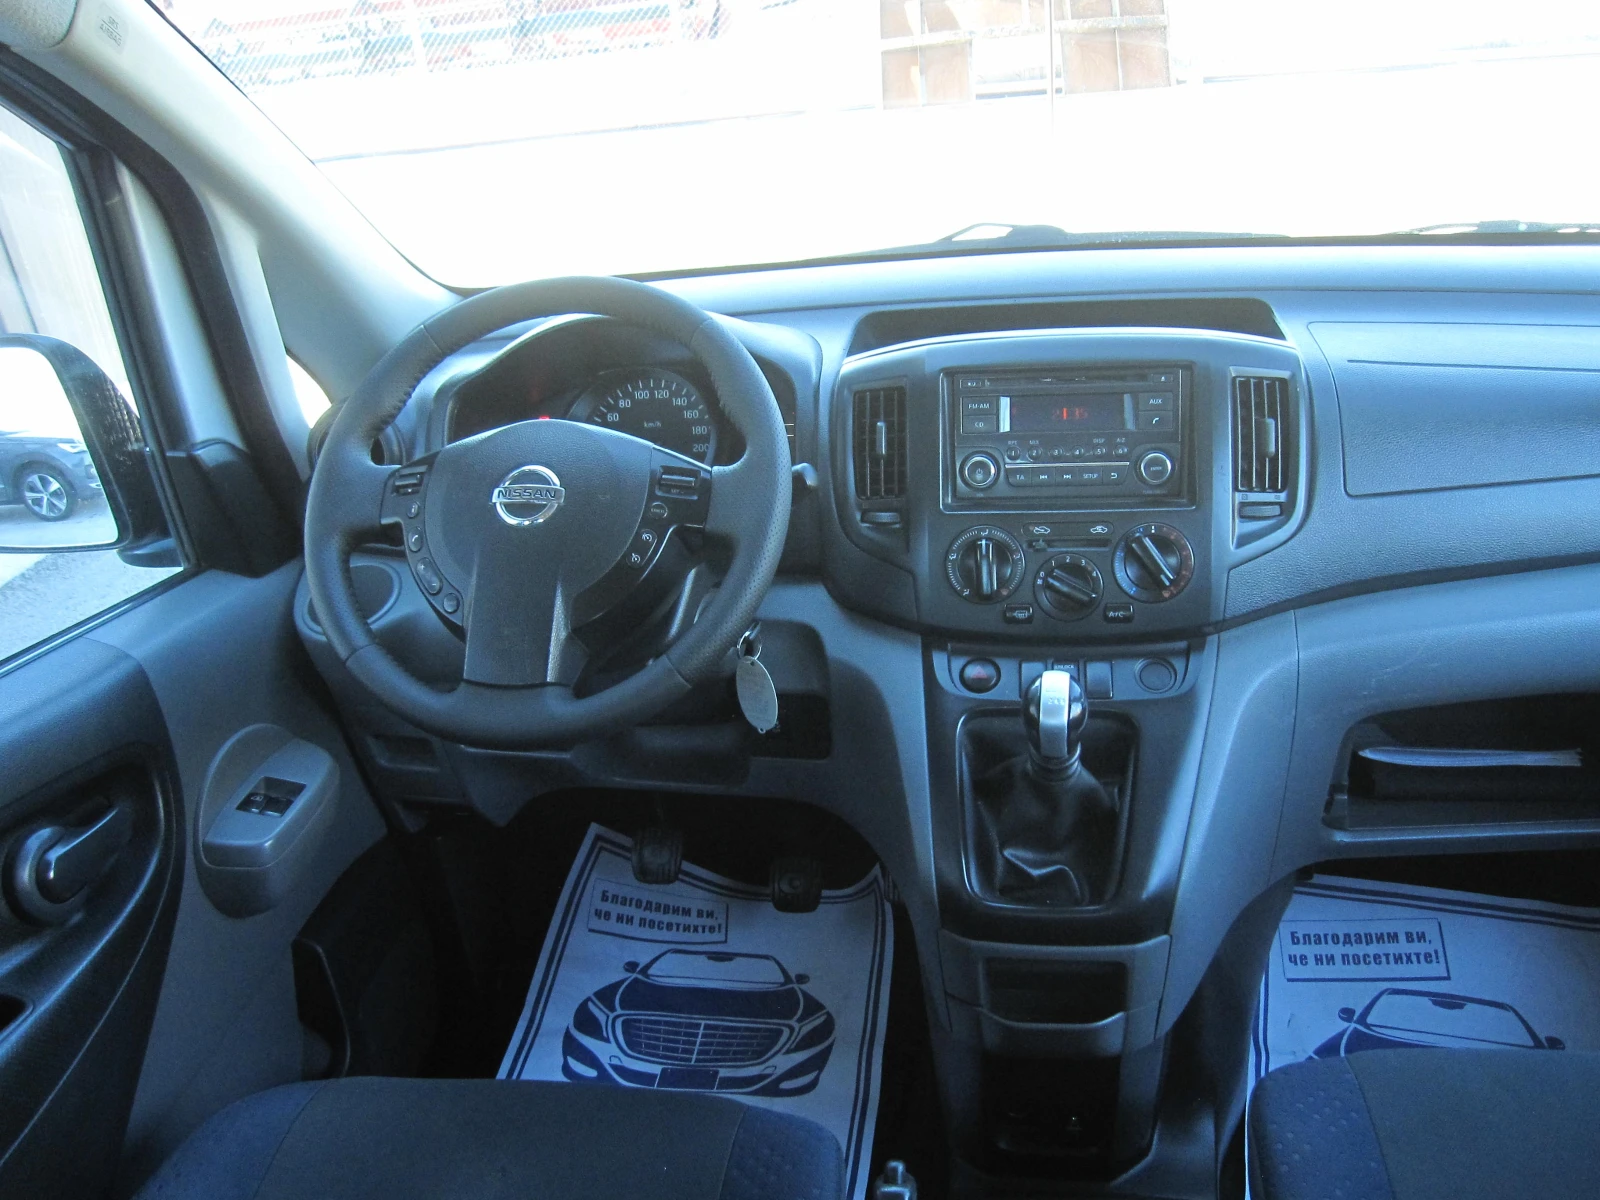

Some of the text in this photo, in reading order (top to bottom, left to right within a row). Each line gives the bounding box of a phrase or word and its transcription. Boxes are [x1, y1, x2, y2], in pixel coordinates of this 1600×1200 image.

[634, 390, 650, 400] 100
[654, 389, 670, 399] 120
[618, 399, 631, 408] 80
[672, 397, 688, 406] 140
[607, 412, 619, 422] 60
[683, 410, 699, 419] 160
[692, 425, 708, 435] 180
[693, 444, 709, 452] 200
[497, 488, 557, 500] NISSAN
[600, 889, 692, 918] Благодарим
[594, 908, 722, 935] че ни посетихте!
[1290, 930, 1432, 948] Благодарим ви,
[1288, 949, 1441, 967] че ни посетихте!
